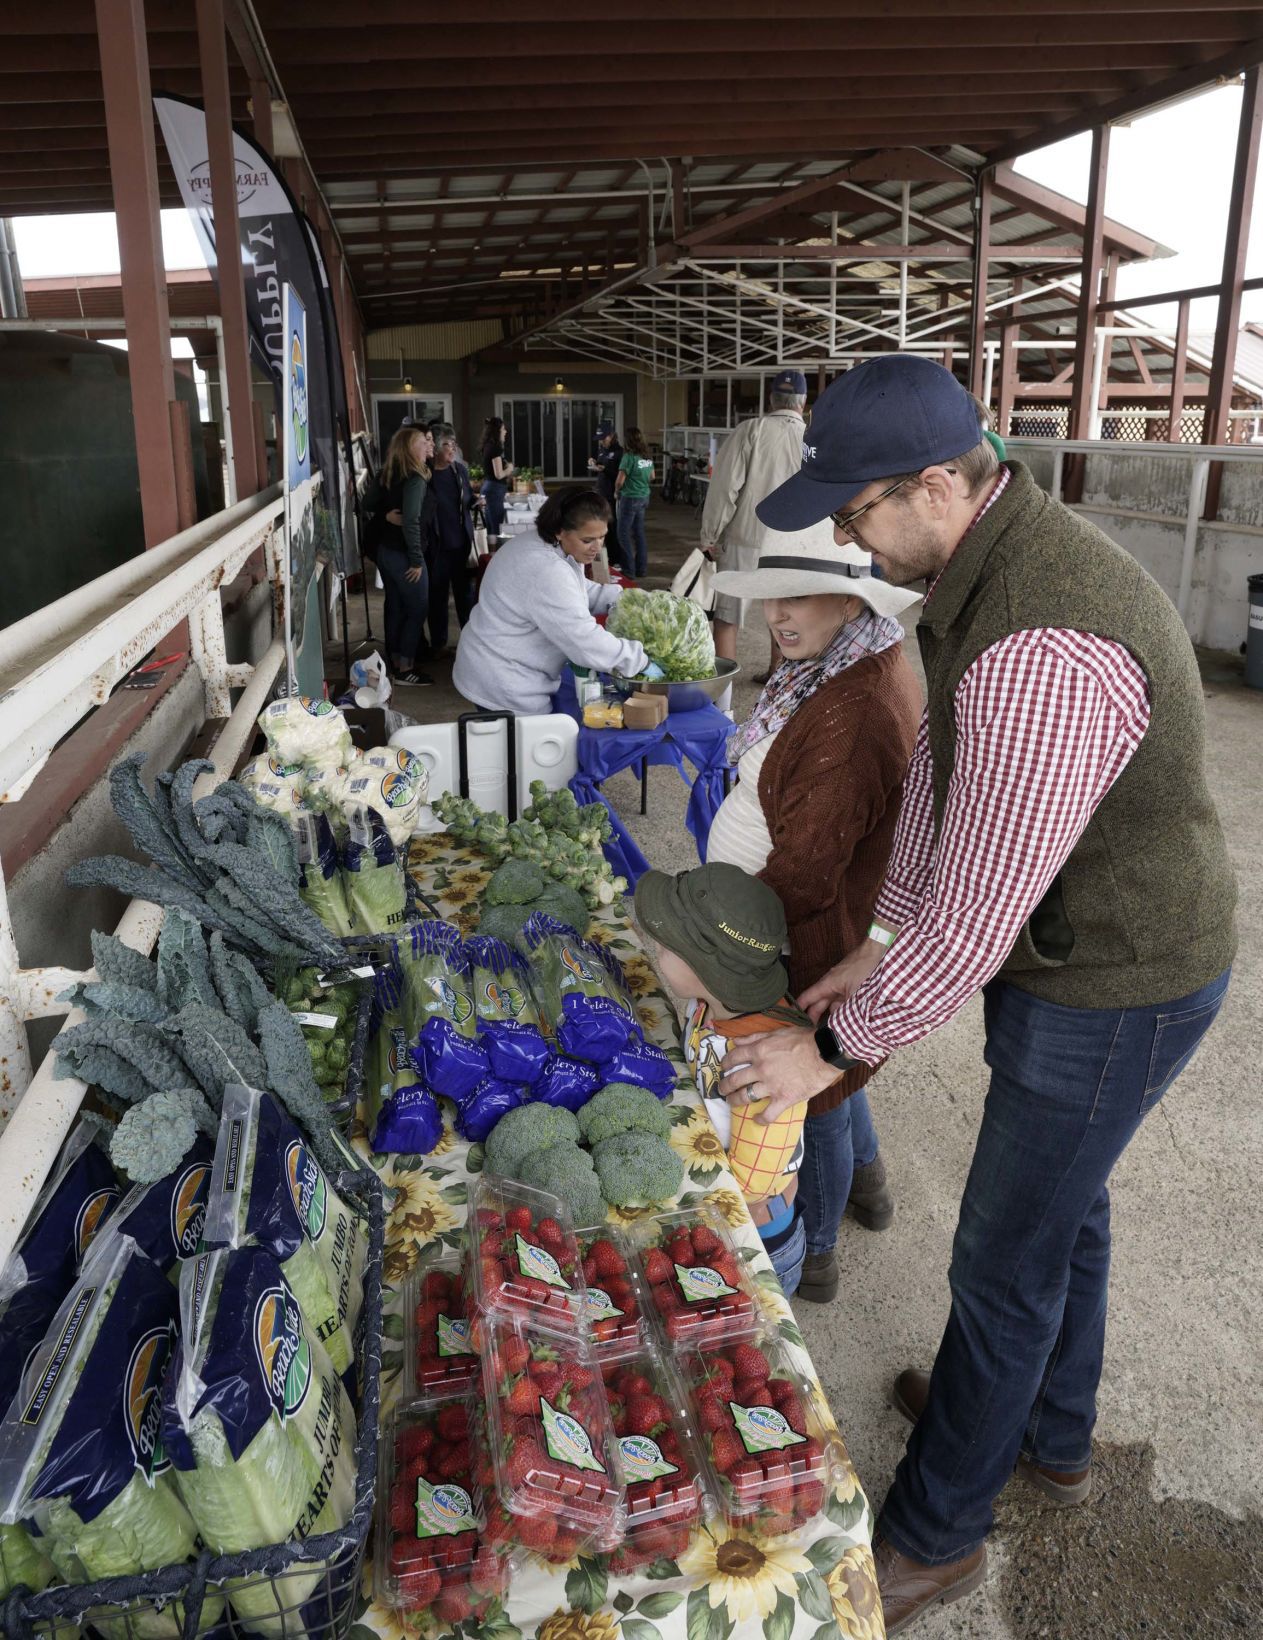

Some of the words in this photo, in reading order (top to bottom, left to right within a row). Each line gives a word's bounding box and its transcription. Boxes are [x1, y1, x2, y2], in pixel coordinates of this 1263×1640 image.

[331, 1213, 348, 1275] JUMBO
[285, 1306, 299, 1337] Side
[34, 1388, 48, 1410] EASY
[44, 1365, 59, 1388] OPEN
[56, 1346, 67, 1363] AND
[64, 1298, 88, 1345] RESEALABLE
[272, 1335, 300, 1398] Beach
[314, 1375, 332, 1455] JUMBO
